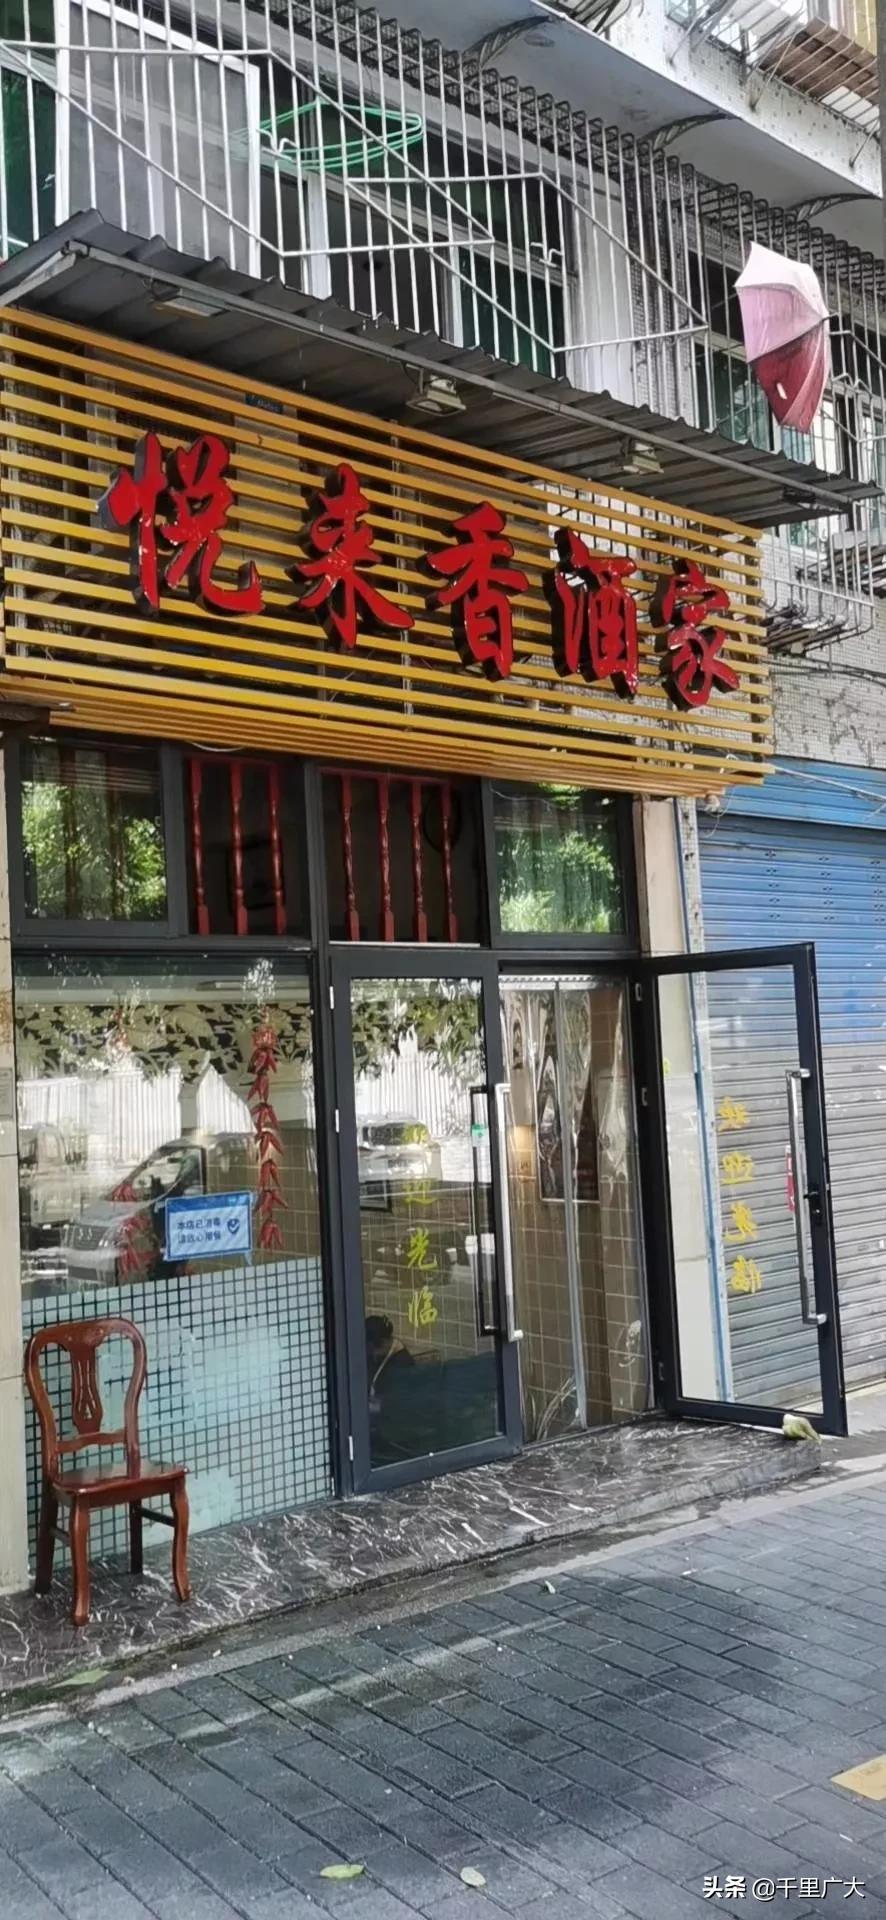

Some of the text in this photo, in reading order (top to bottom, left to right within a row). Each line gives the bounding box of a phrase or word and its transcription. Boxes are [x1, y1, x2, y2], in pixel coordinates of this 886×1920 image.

[102, 430, 740, 709] 悦来香酒家
